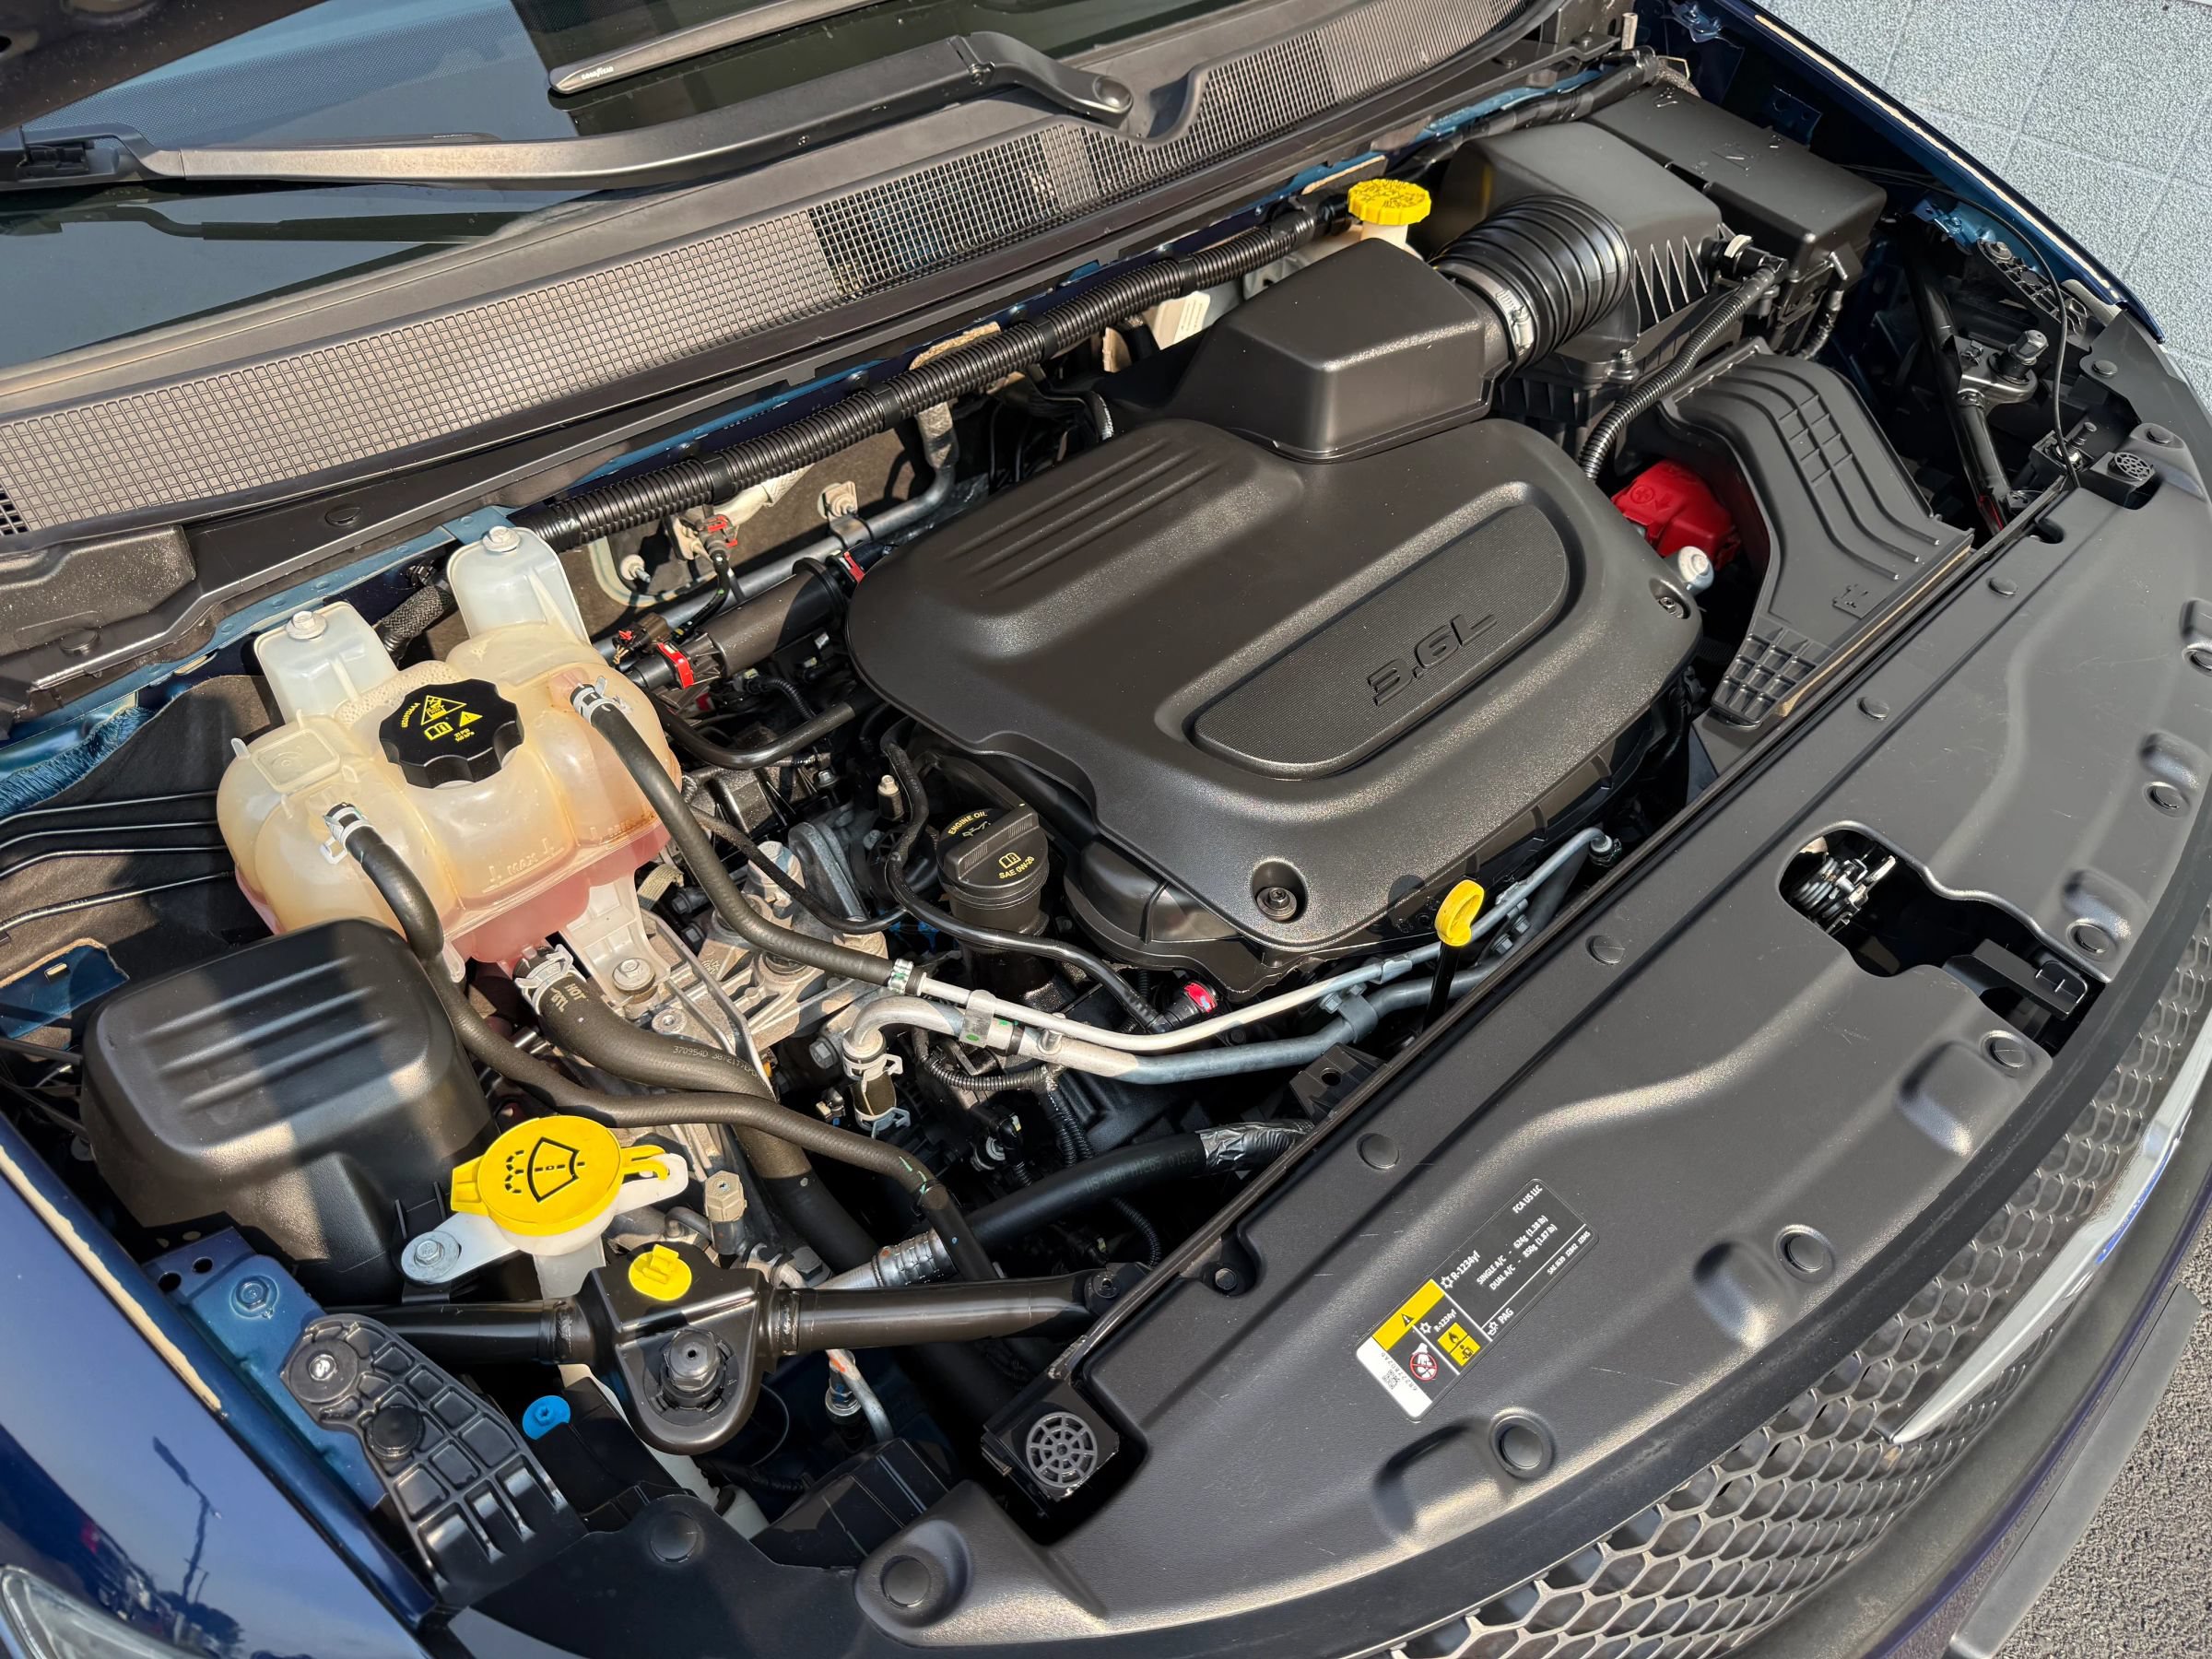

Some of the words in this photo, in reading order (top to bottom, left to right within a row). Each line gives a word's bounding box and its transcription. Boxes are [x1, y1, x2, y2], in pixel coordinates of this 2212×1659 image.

[1367, 613, 1498, 707] 3.6L
[947, 815, 973, 835] ENGINE
[973, 810, 988, 818] OIL
[998, 867, 1016, 879] SAE
[1016, 855, 1035, 873] 0W-20
[564, 982, 587, 1001] HOT
[1512, 1201, 1527, 1214] FCA
[1523, 1193, 1534, 1204] US
[1530, 1184, 1543, 1196] LLC
[1450, 1250, 1481, 1281] R-1234yf
[1477, 1264, 1498, 1285] SINGLE
[1494, 1254, 1507, 1268] A/C
[1489, 1274, 1507, 1290] DUAL
[1503, 1264, 1516, 1277] A/C
[1433, 1309, 1457, 1332] R-1234yf
[1498, 1307, 1514, 1324] PAG
